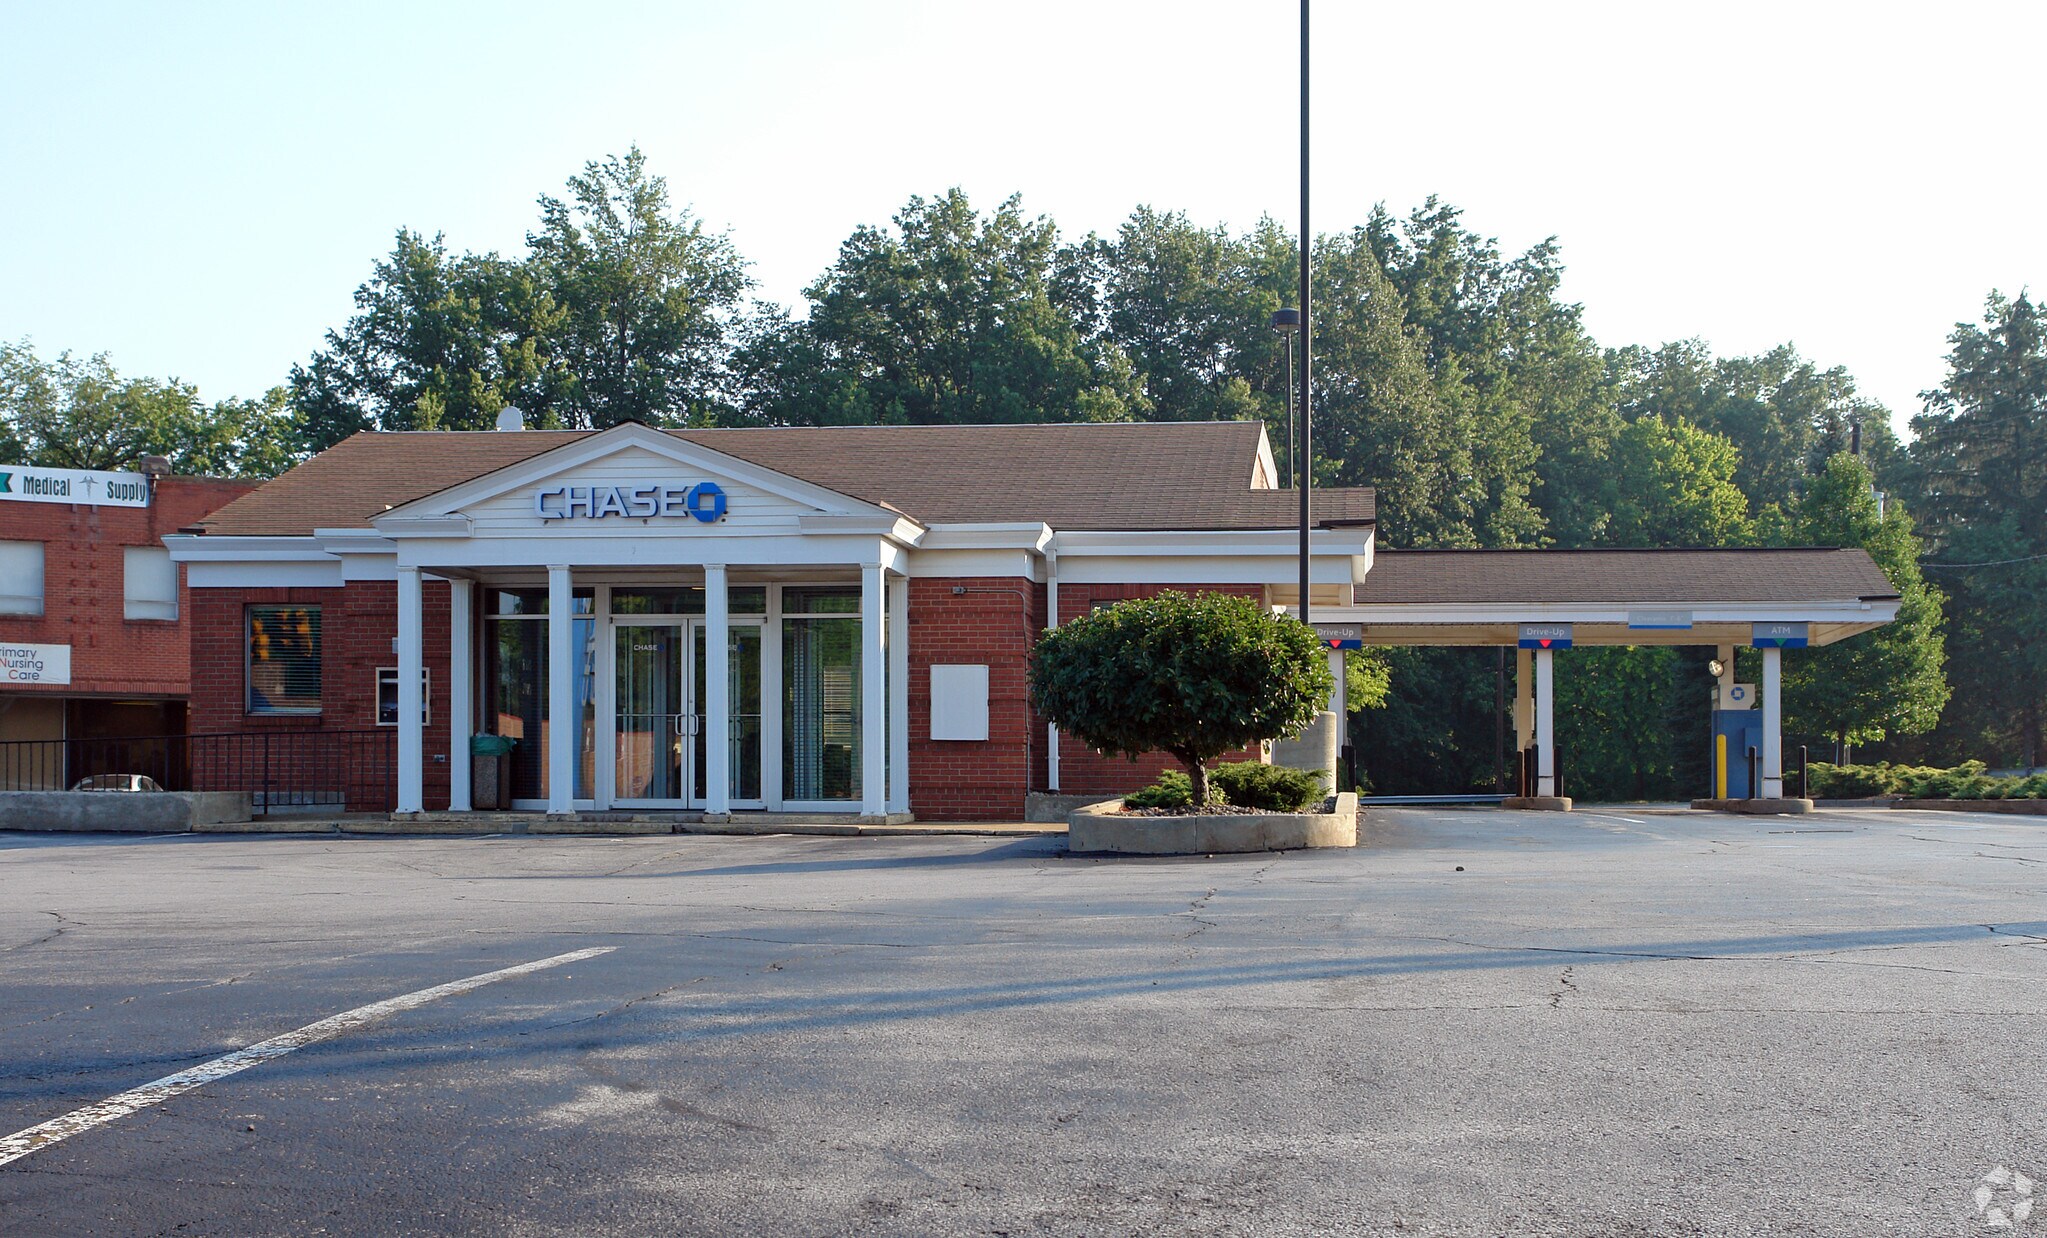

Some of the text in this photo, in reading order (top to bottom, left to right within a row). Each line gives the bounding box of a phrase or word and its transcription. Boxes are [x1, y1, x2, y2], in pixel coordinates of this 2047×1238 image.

[23, 475, 146, 502] Medical Supply
[535, 486, 688, 519] CHASE
[1317, 628, 1354, 637] Drive-Up
[1526, 627, 1565, 637] Drive-Up
[1771, 626, 1791, 634] ATM
[0, 658, 43, 671] Nursing
[9, 669, 40, 680] Care
